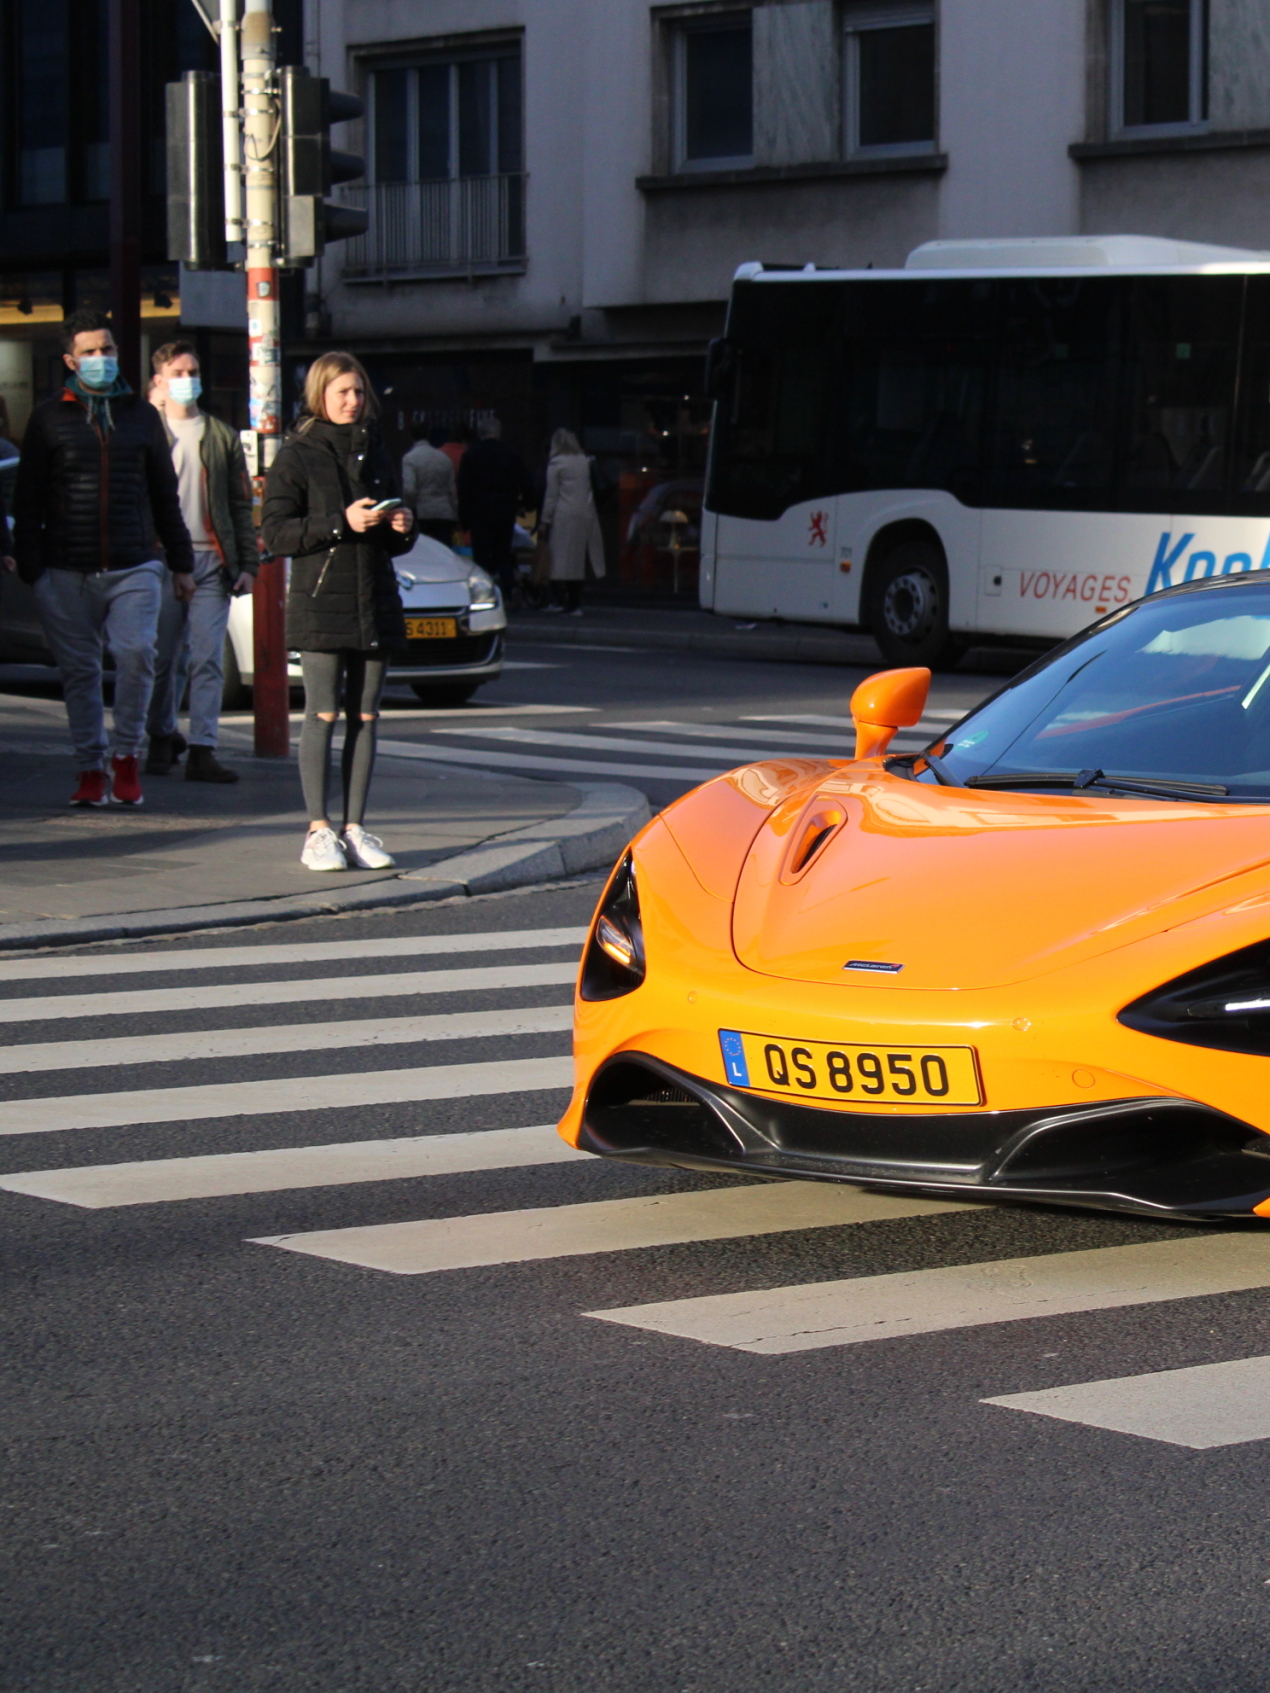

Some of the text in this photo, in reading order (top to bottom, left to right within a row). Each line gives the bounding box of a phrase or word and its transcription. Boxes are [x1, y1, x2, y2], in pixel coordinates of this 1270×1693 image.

[732, 1043, 949, 1096] L QS 8950
